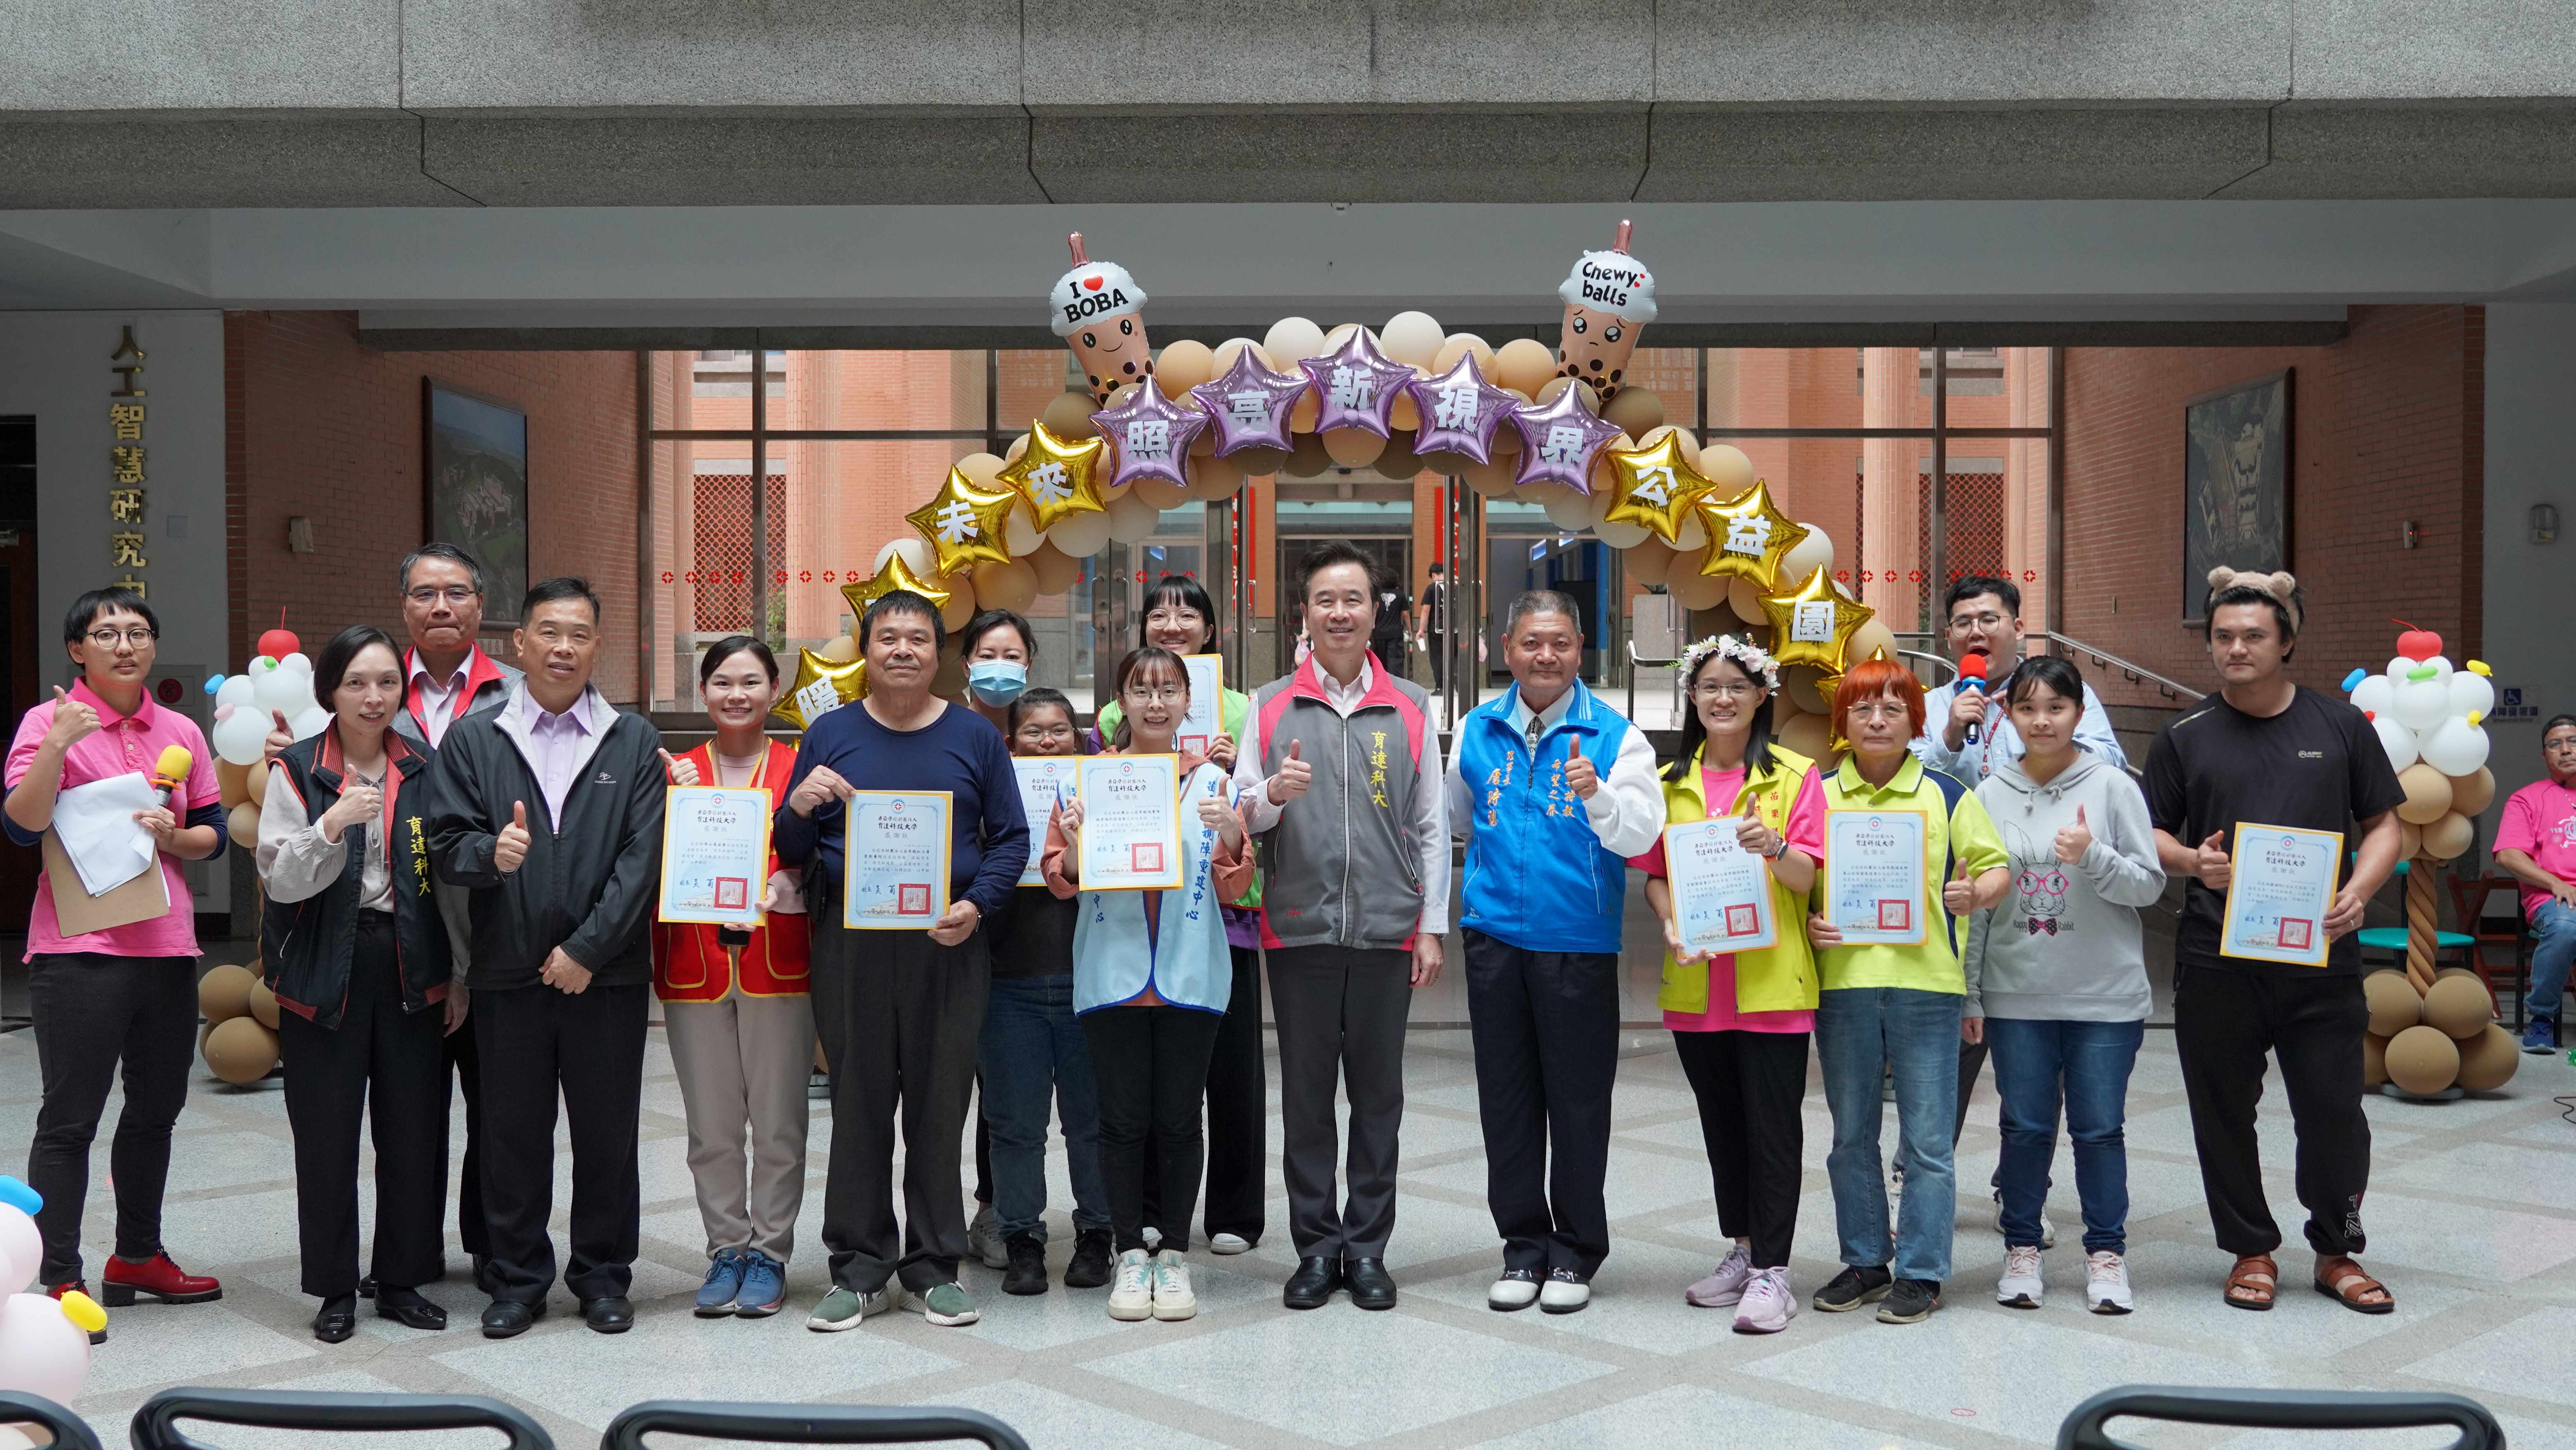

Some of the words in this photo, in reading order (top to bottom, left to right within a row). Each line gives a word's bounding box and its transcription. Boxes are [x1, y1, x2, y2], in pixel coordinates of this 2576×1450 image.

[1583, 261, 1638, 288] Chewy
[1070, 281, 1081, 299] I
[1582, 280, 1627, 307] balls
[1063, 288, 1129, 323] BOBA
[1370, 730, 1388, 808] 育達科大
[406, 815, 431, 897] 育達科大
[2013, 919, 2027, 932] Happy
[2058, 920, 2074, 931] Rabbit
